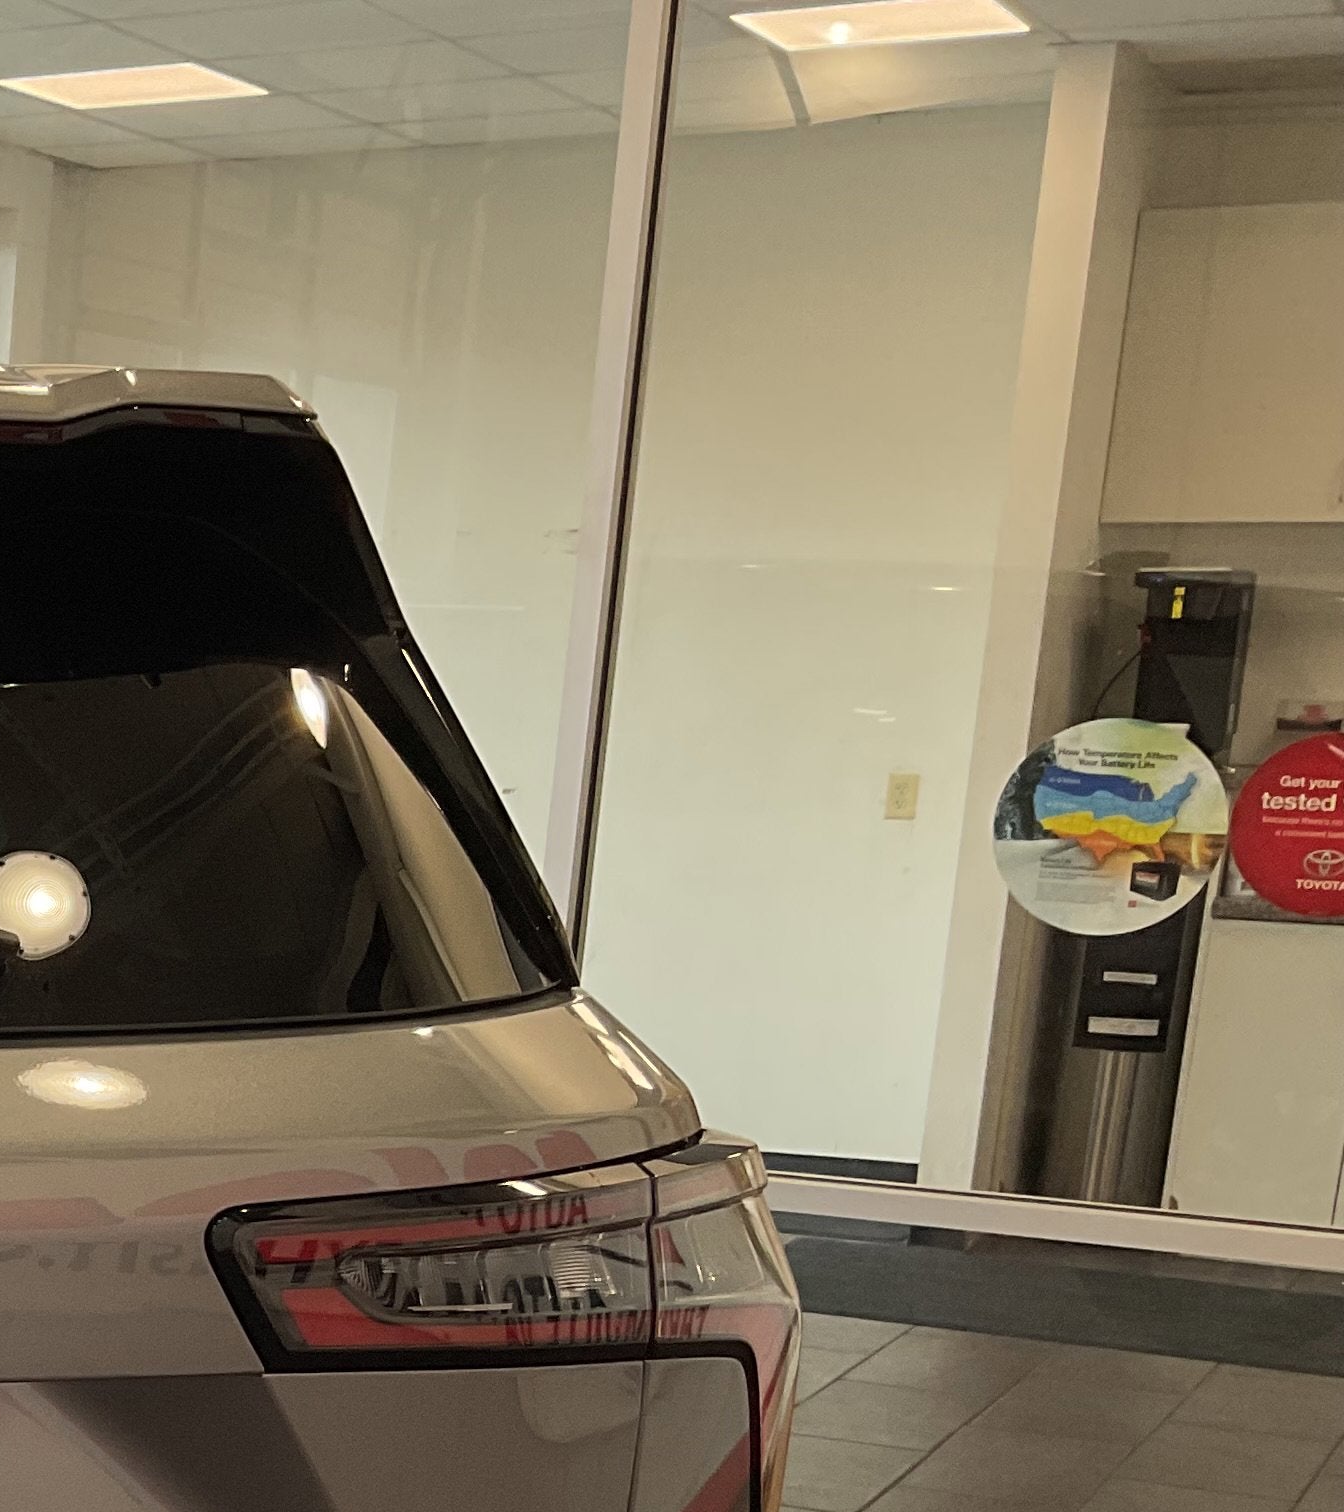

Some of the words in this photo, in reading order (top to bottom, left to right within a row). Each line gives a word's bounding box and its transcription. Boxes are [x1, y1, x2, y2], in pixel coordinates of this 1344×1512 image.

[1279, 775, 1305, 788] Get
[1309, 777, 1342, 790] your
[1261, 791, 1337, 812] tested
